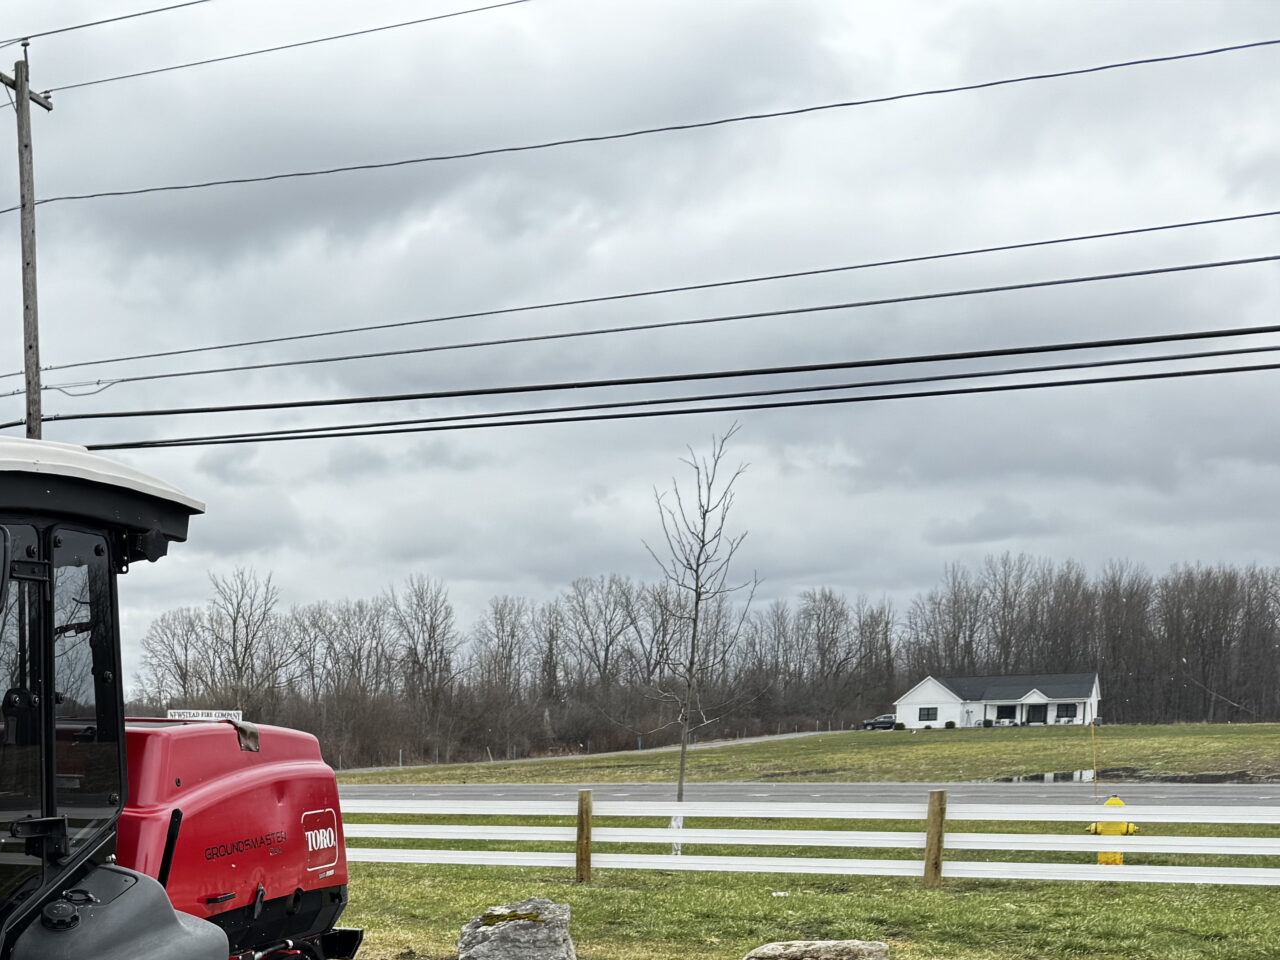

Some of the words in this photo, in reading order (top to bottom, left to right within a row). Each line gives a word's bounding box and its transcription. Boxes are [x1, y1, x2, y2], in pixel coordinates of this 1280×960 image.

[170, 711, 200, 719] NEWSTEAD
[214, 711, 241, 720] COMPANY
[305, 827, 335, 851] TORO
